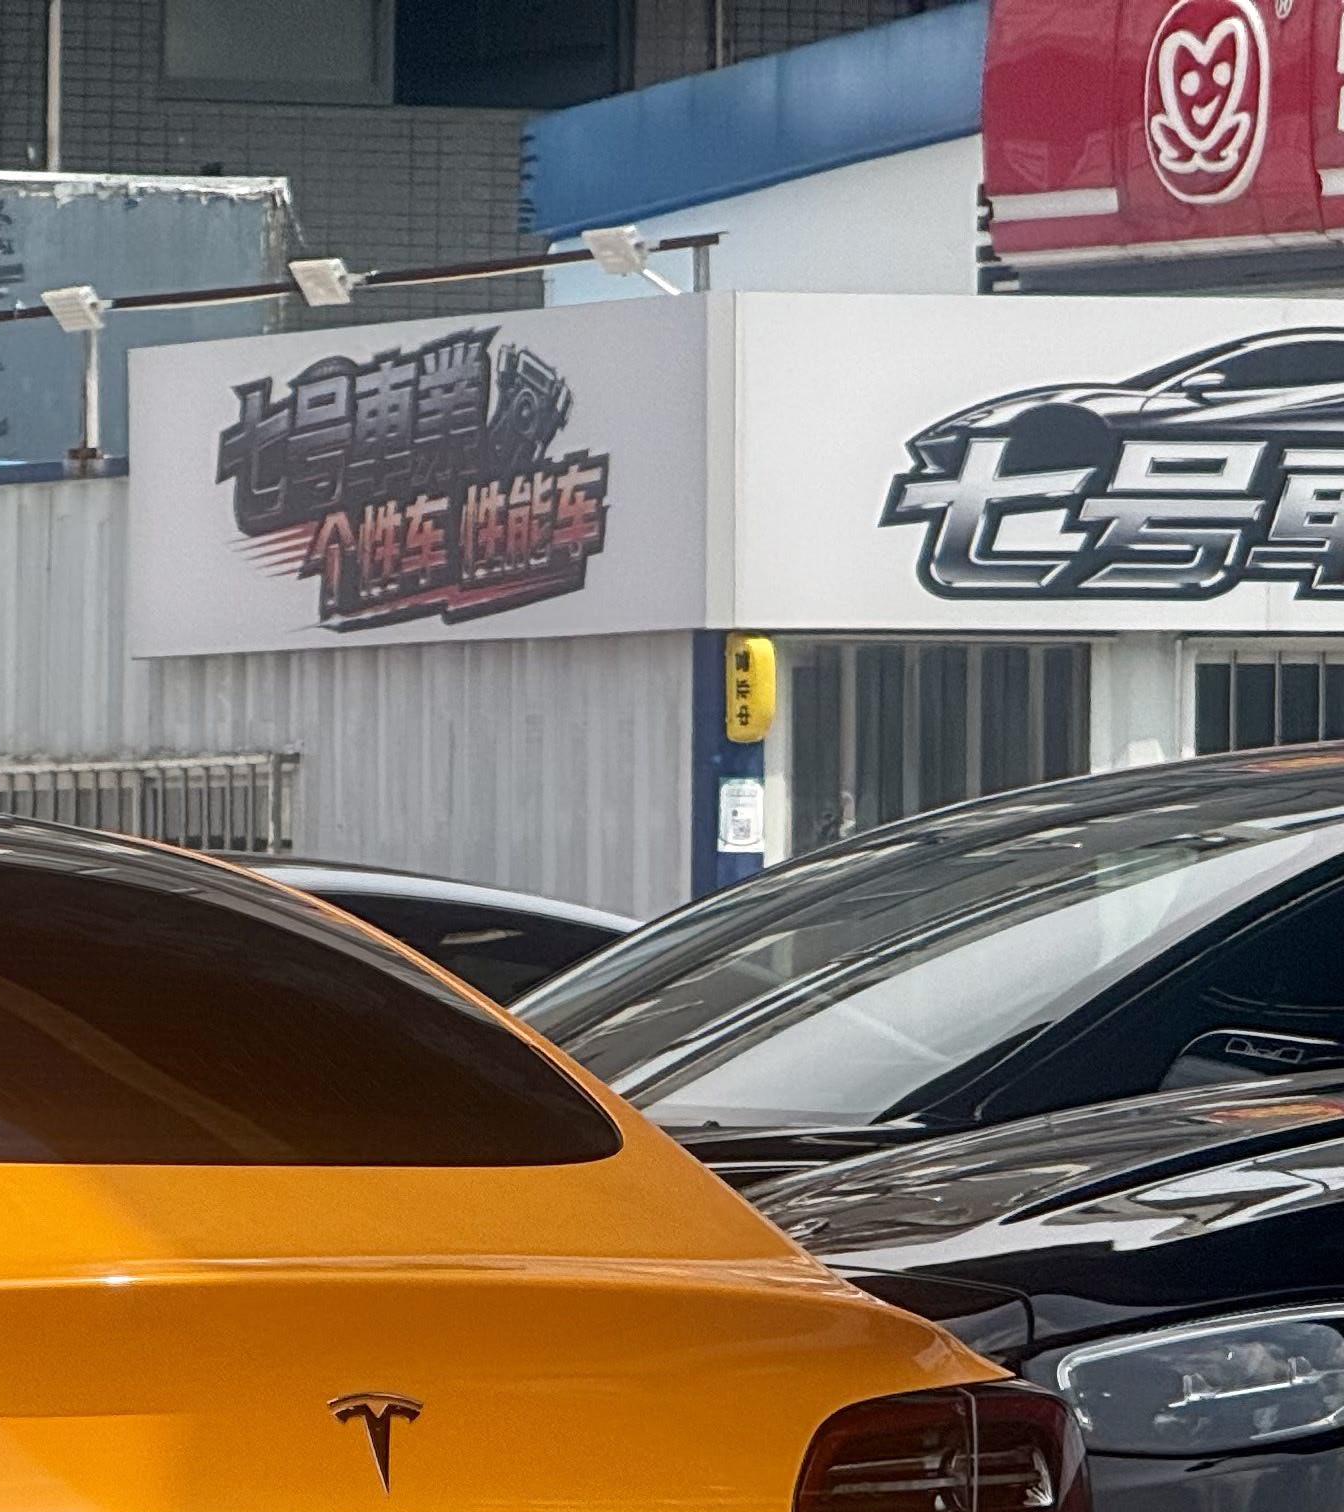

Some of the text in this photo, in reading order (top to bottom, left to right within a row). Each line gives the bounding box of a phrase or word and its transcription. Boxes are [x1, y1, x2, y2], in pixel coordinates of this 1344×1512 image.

[315, 463, 606, 608] 个性车 性能车
